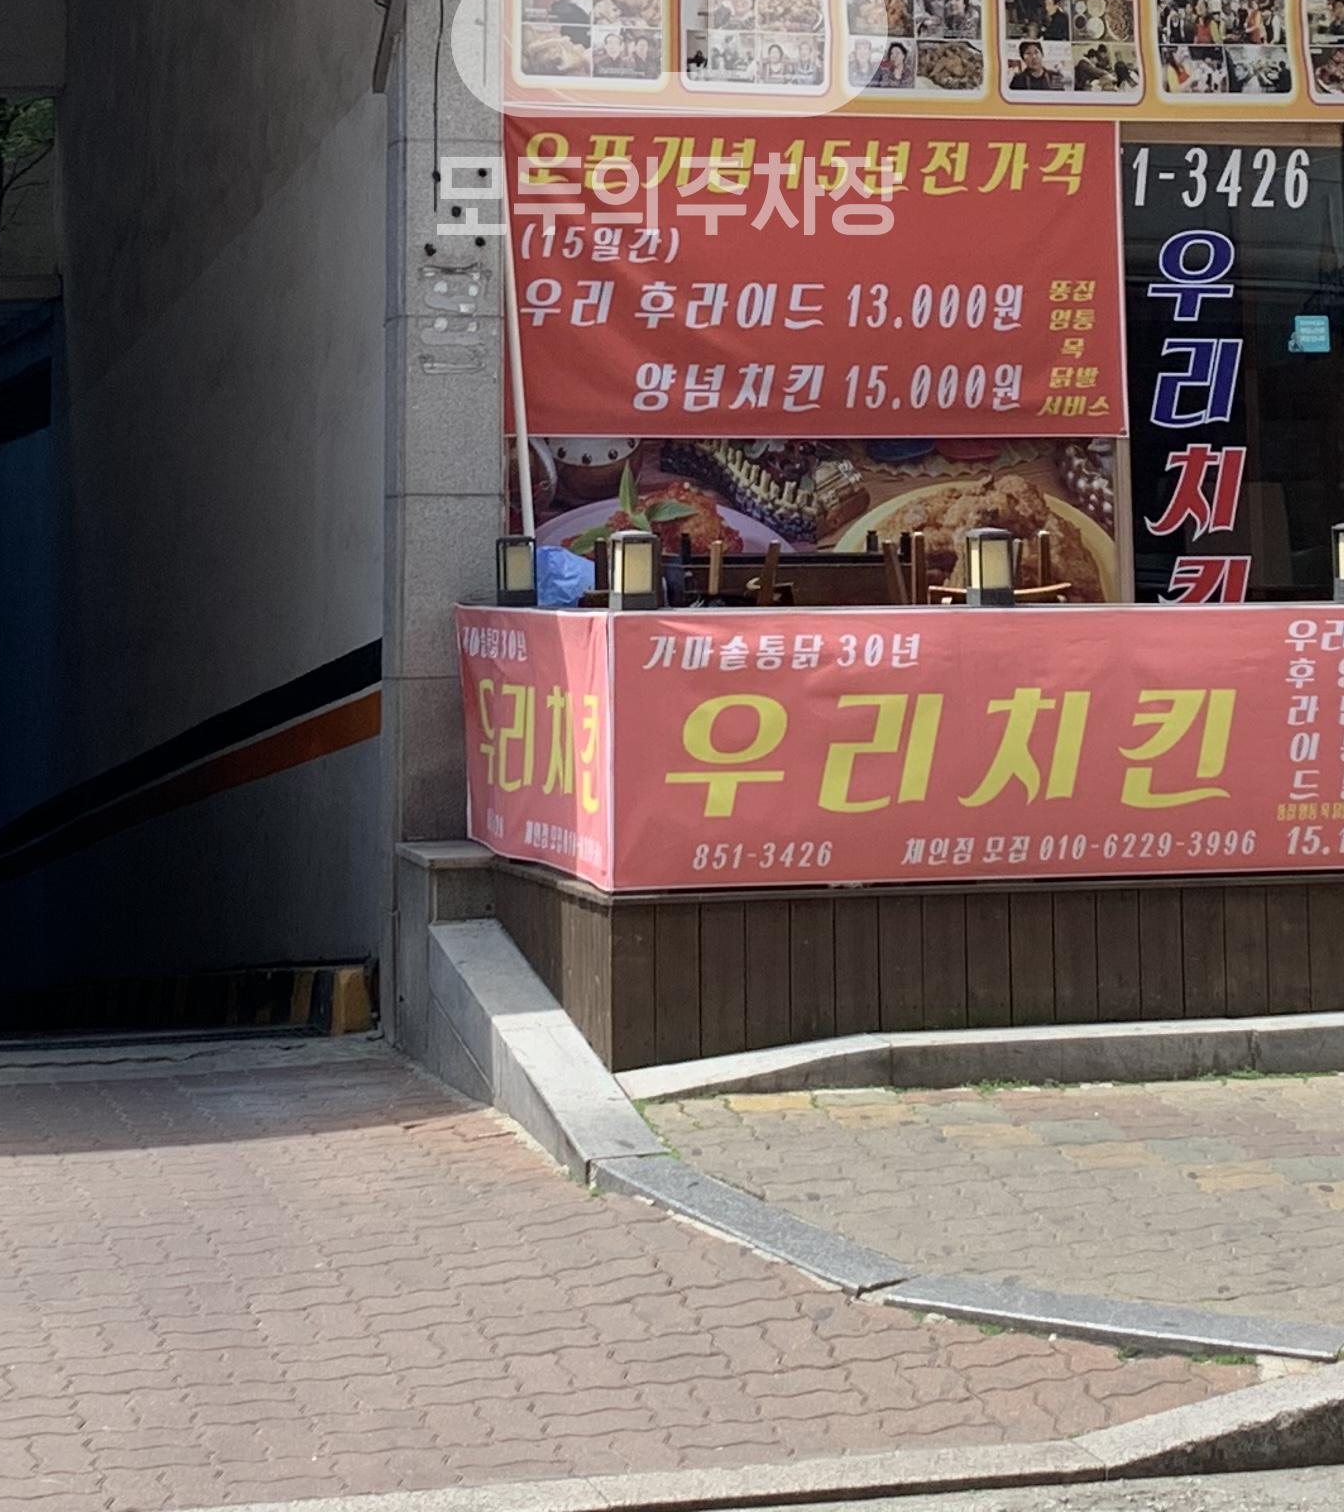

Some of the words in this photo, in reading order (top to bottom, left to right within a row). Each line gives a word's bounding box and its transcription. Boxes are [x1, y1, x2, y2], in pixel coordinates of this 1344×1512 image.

[1122, 146, 1311, 210] 1-3426
[520, 221, 681, 265] (15일간)
[519, 276, 614, 329] 우리
[635, 280, 826, 331] 후라이드
[846, 282, 1025, 333] 13.000원
[632, 360, 825, 414] 양념치킨
[844, 361, 1024, 412] 15.000원
[1036, 395, 1111, 417] 서비스
[642, 633, 832, 672] 가마솥통닭
[838, 632, 922, 669] 30년
[663, 687, 1239, 820] 우리치킨
[692, 839, 834, 872] 851-3426
[901, 834, 979, 867] 체인점
[1037, 829, 1258, 861] 010-6229-3996
